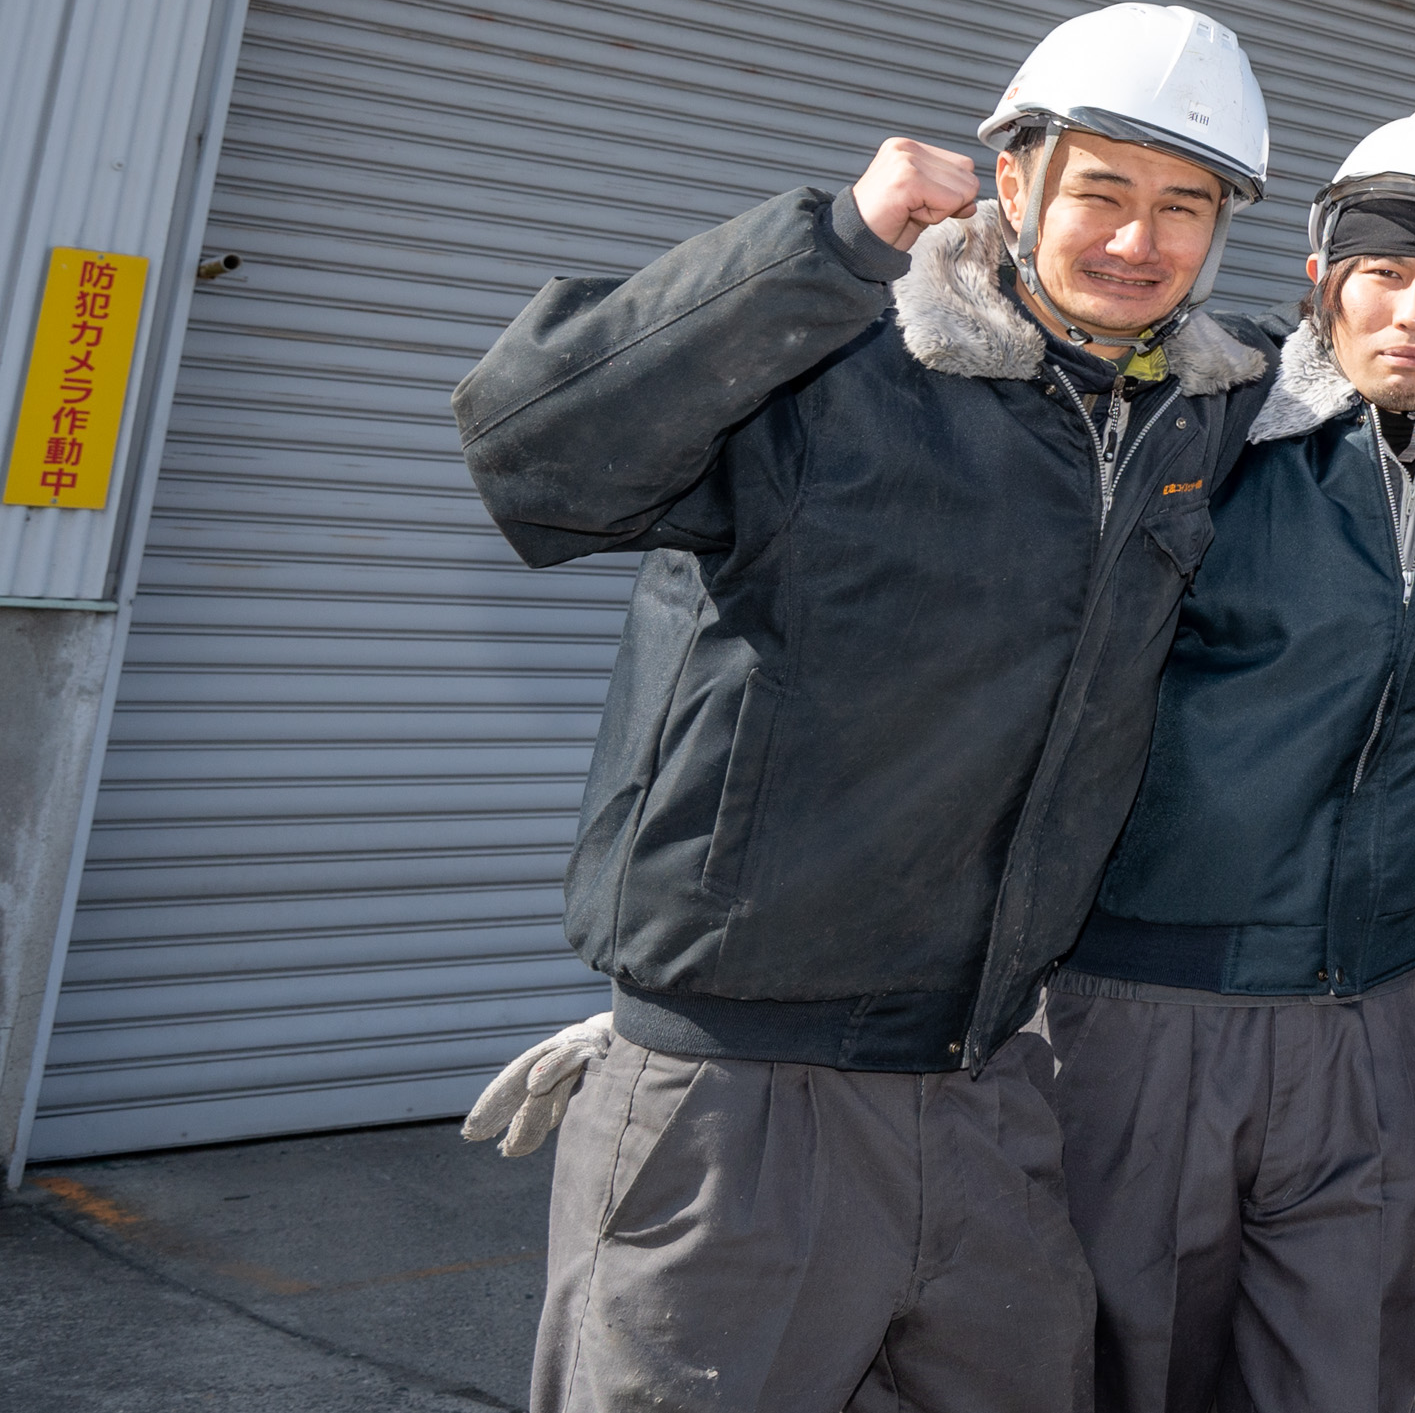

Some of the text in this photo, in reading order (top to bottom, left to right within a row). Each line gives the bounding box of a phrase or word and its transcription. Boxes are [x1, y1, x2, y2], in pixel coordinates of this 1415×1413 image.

[39, 260, 118, 497] 防犯カメラ作動中
